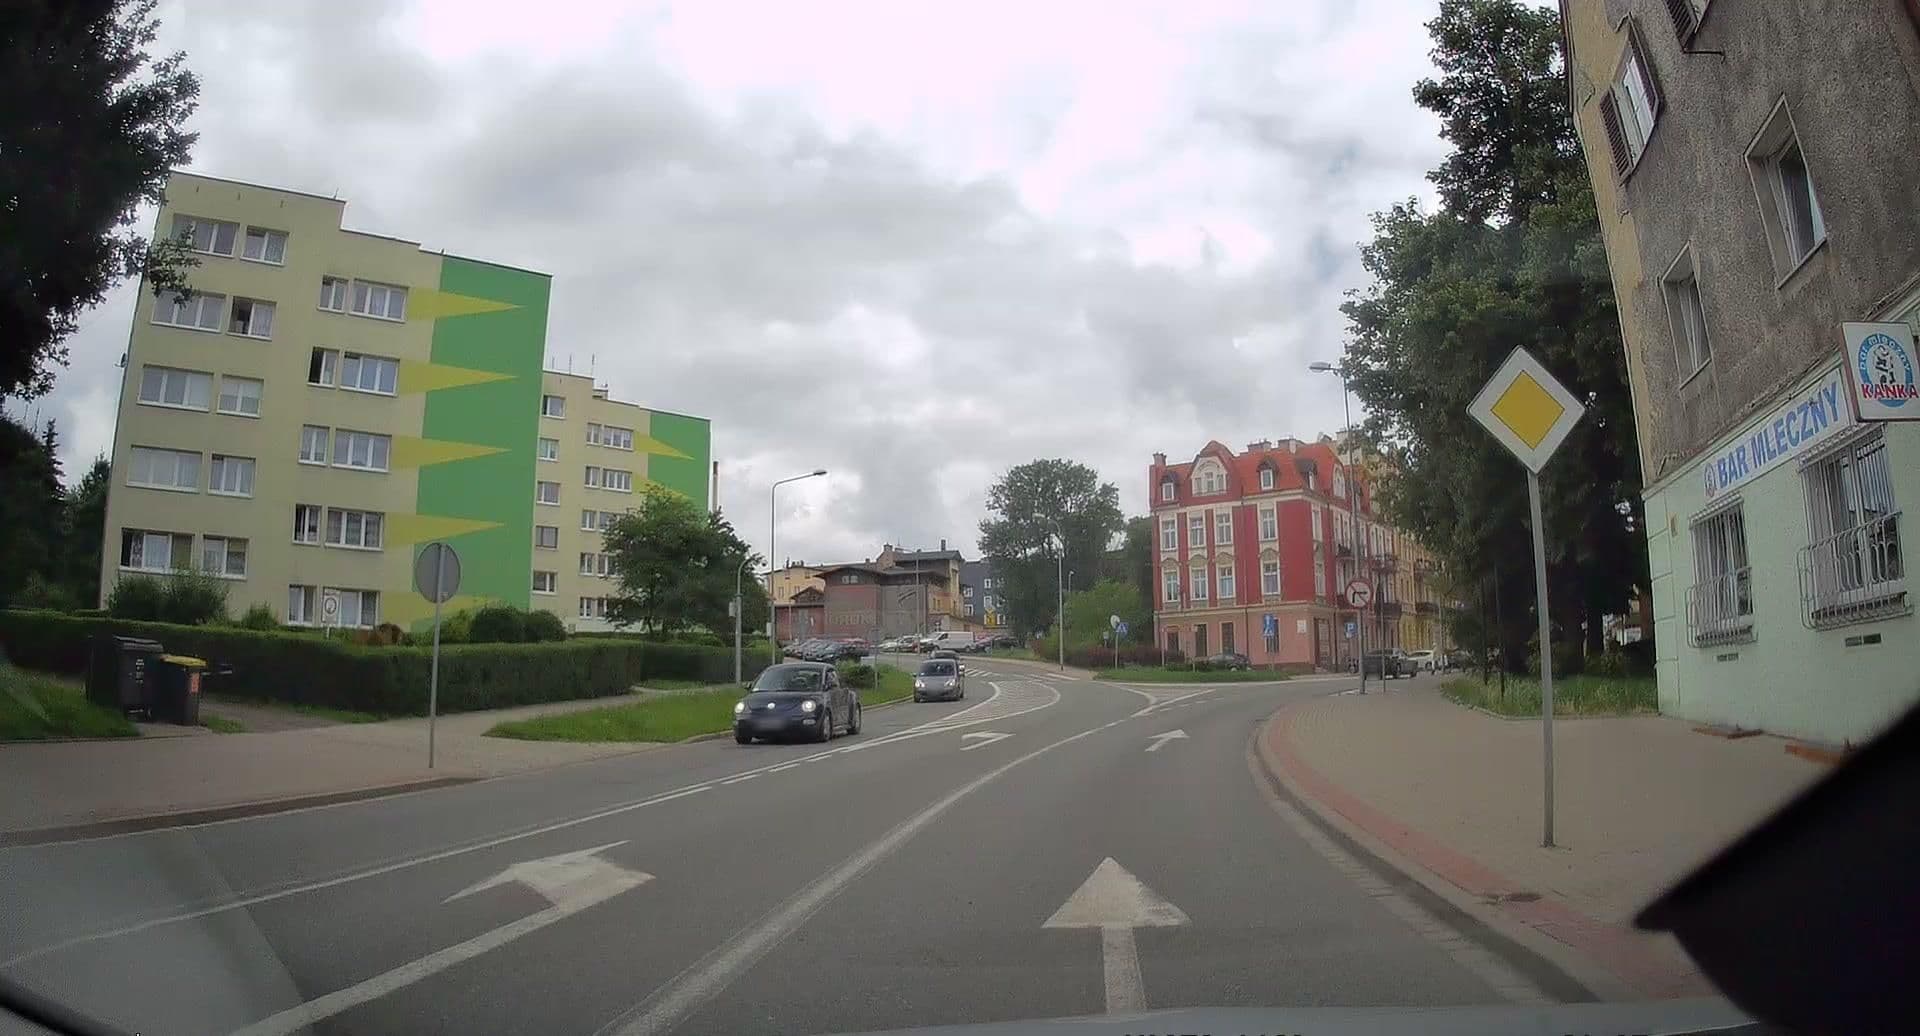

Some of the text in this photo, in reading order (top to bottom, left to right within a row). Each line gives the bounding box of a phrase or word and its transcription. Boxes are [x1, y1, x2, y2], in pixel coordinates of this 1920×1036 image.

[1861, 383, 1919, 399] KANKA
[1717, 380, 1839, 489] BAR MLECZNY
